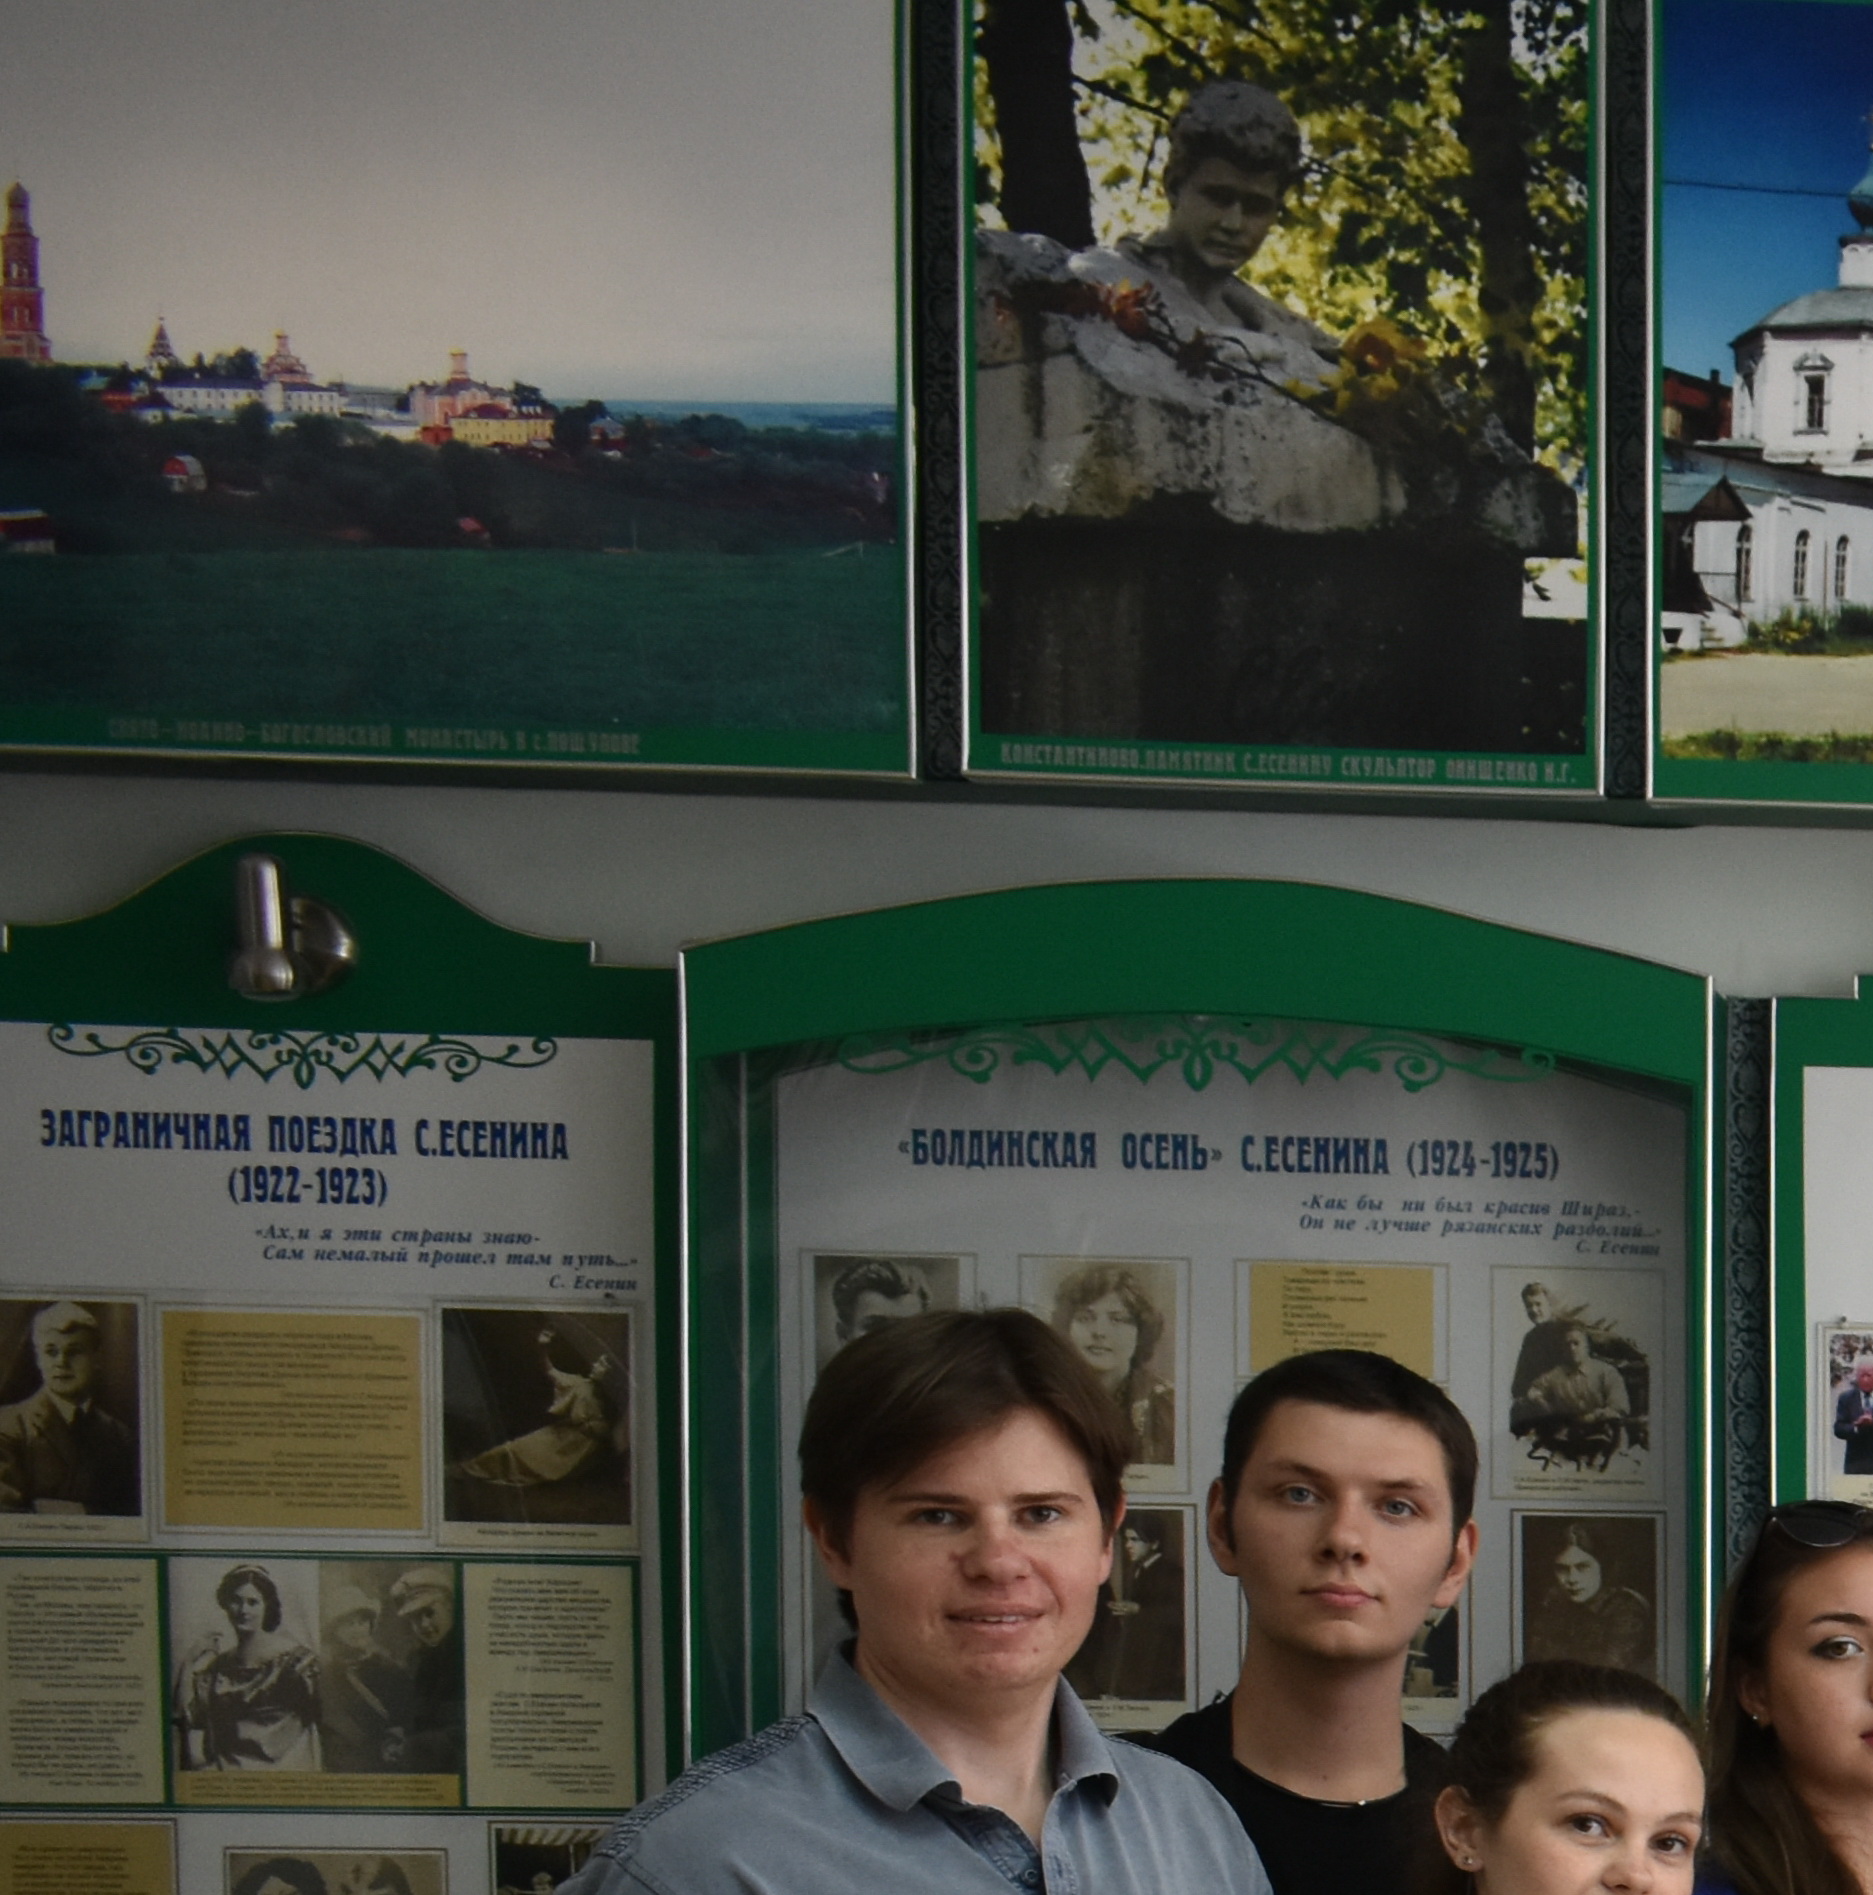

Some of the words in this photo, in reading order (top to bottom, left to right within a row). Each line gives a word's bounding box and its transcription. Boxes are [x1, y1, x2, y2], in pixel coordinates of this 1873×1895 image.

[1341, 756, 1436, 780] СКУЛЬПТОР
[40, 1108, 250, 1151] ЗАГРАНИЧНАЯ
[268, 1115, 398, 1156] ПОЕЗДКА
[413, 1119, 570, 1161] С.ЕСЕНИНА
[899, 1127, 1097, 1171] «БОЛДИНСКАЯ
[1121, 1134, 1223, 1171] ОСЕНЬ»
[1239, 1134, 1390, 1176] С.ЕСЕНИНА
[1406, 1140, 1559, 1181] (1924-1925)
[228, 1167, 389, 1208] (1922-1923)
[1301, 1193, 1346, 1212] «Как
[1355, 1194, 1385, 1212] бы
[1434, 1195, 1476, 1214] был
[1489, 1202, 1549, 1218] красив
[342, 1229, 381, 1241] эти
[391, 1228, 472, 1248] страны
[1297, 1214, 1325, 1230] Он
[1335, 1219, 1356, 1231] не
[1364, 1220, 1428, 1236] лучше
[1439, 1220, 1543, 1239] рязанских
[263, 1245, 304, 1261] Сам
[314, 1245, 409, 1263] немалый
[418, 1250, 497, 1268] прошел
[507, 1253, 552, 1265] там
[1575, 1239, 1592, 1253] С.
[1600, 1241, 1660, 1256] Есенин
[549, 1275, 566, 1290] С.
[573, 1276, 638, 1290] Есенин
